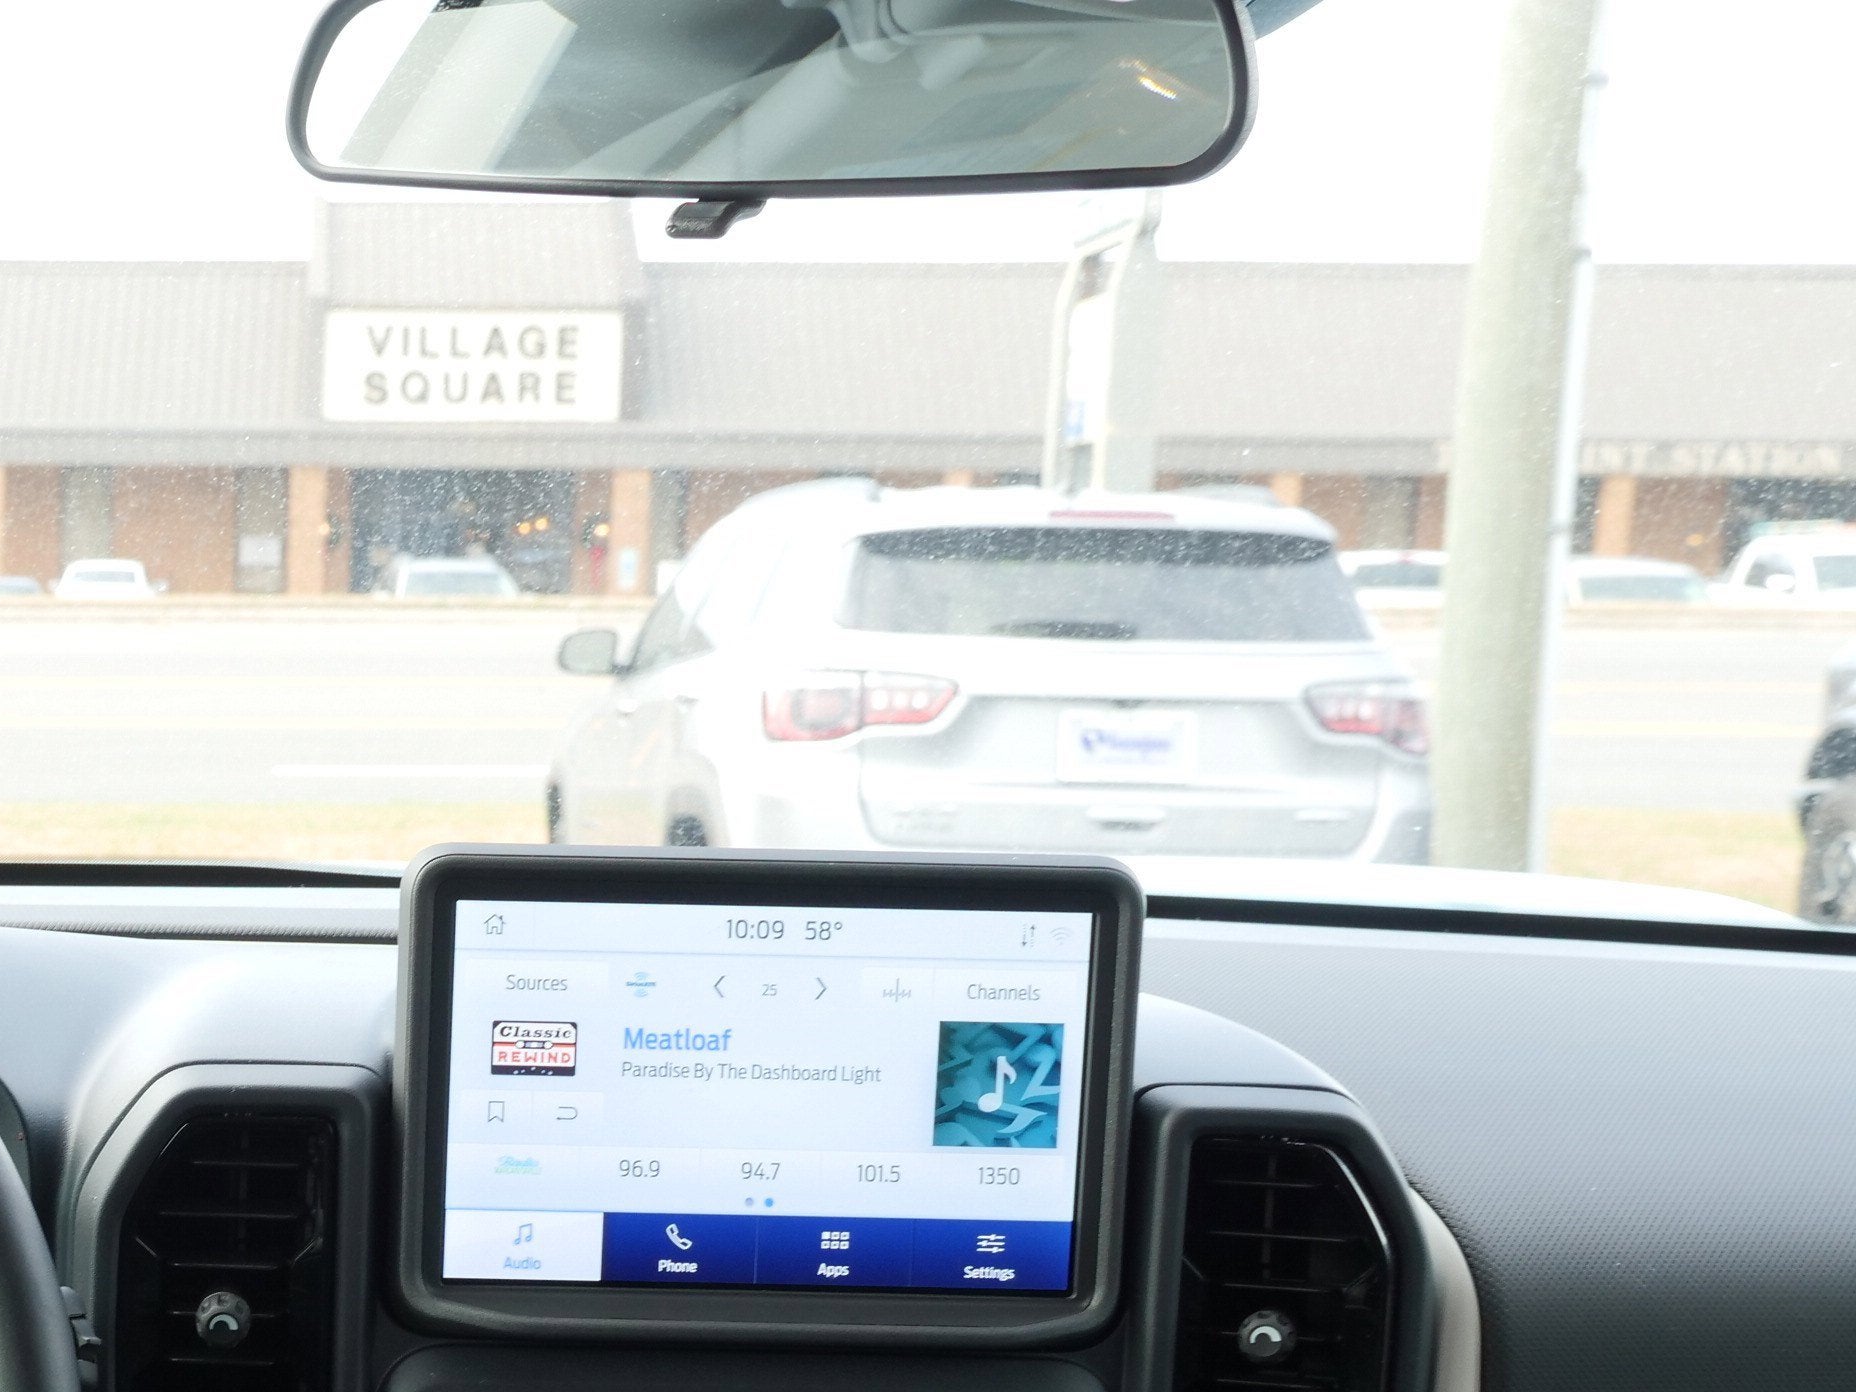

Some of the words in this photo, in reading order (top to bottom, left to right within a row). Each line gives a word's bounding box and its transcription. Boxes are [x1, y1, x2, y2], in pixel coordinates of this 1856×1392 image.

[366, 325, 580, 359] VILLAGE
[363, 371, 576, 405] SQUARE
[726, 919, 785, 940] 10:09
[805, 920, 843, 941] 58°
[505, 974, 568, 991] Sources
[761, 984, 777, 997] 25
[967, 983, 1041, 1002] Channels
[500, 1026, 572, 1038] Classic
[623, 1027, 733, 1052] Meatloaf
[498, 1051, 571, 1063] REWIND
[621, 1061, 690, 1079] Paradise
[694, 1063, 713, 1082] By
[717, 1063, 747, 1080] The
[751, 1063, 837, 1082] Dashboard
[842, 1065, 882, 1085] Light
[619, 1159, 660, 1178] 96.9
[741, 1161, 781, 1181] 94.7
[857, 1164, 901, 1183] 101.5
[978, 1166, 1021, 1186] 1350
[503, 1256, 541, 1270] Audio
[657, 1259, 698, 1274] Phone
[817, 1262, 850, 1279] Apps
[963, 1265, 1016, 1282] Settings
